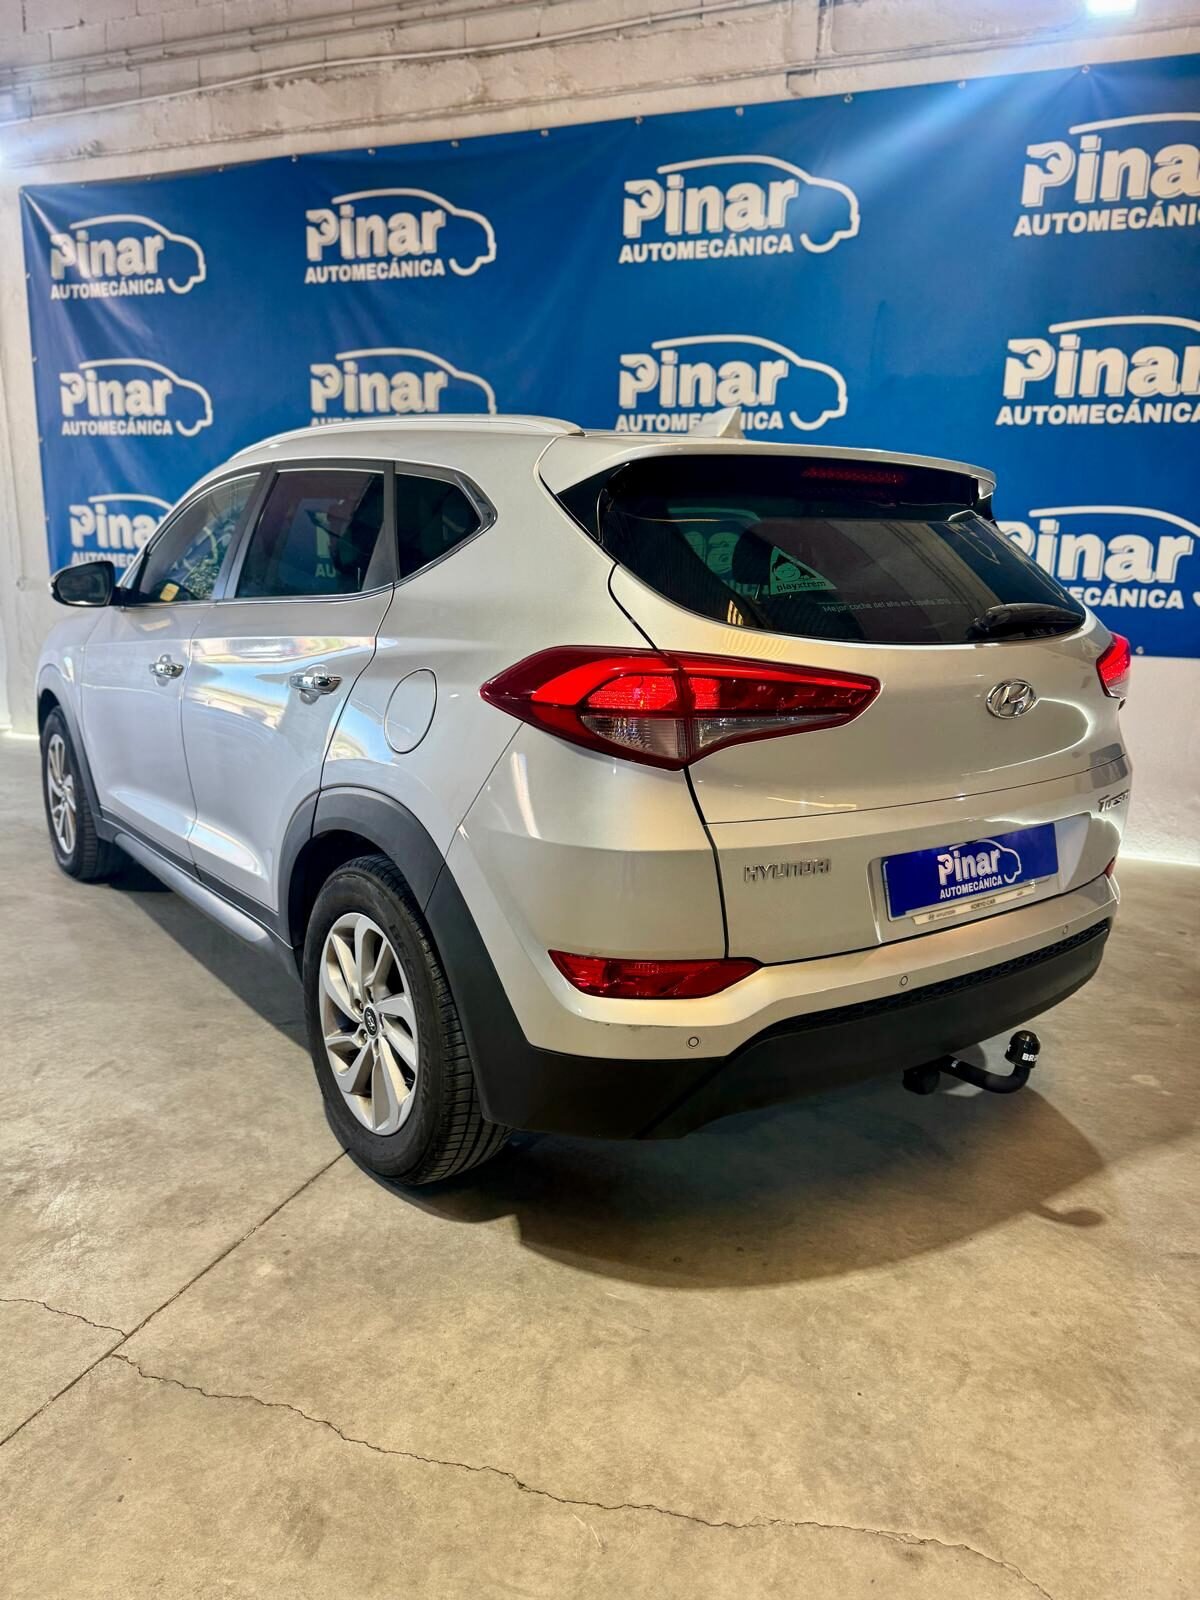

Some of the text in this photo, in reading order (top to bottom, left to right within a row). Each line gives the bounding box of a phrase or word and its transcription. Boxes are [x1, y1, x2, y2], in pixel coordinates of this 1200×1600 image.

[1020, 134, 1200, 208] Pina
[623, 174, 799, 239] Pinar
[1013, 201, 1200, 237] AUTOMECÁNI
[306, 204, 446, 262] Pinar
[618, 233, 795, 264] AUTOMECÁNICA
[50, 231, 164, 280] Pinar
[304, 257, 446, 284] AUTOMECÁNICA
[50, 277, 165, 300] AUTOMECÁNICA
[59, 369, 173, 418] Pinar
[310, 361, 448, 413] Pinar
[618, 350, 789, 409] Pinar
[61, 417, 173, 437] AUTOMECÁNICA
[615, 411, 784, 432] AUTOMEICA
[69, 503, 162, 549] Pina
[1065, 583, 1185, 610] ECÁNICA
[743, 858, 832, 882] HYUNDAI
[937, 849, 1000, 884] Pinar
[940, 875, 1002, 899] AUTOMECÁNICA
